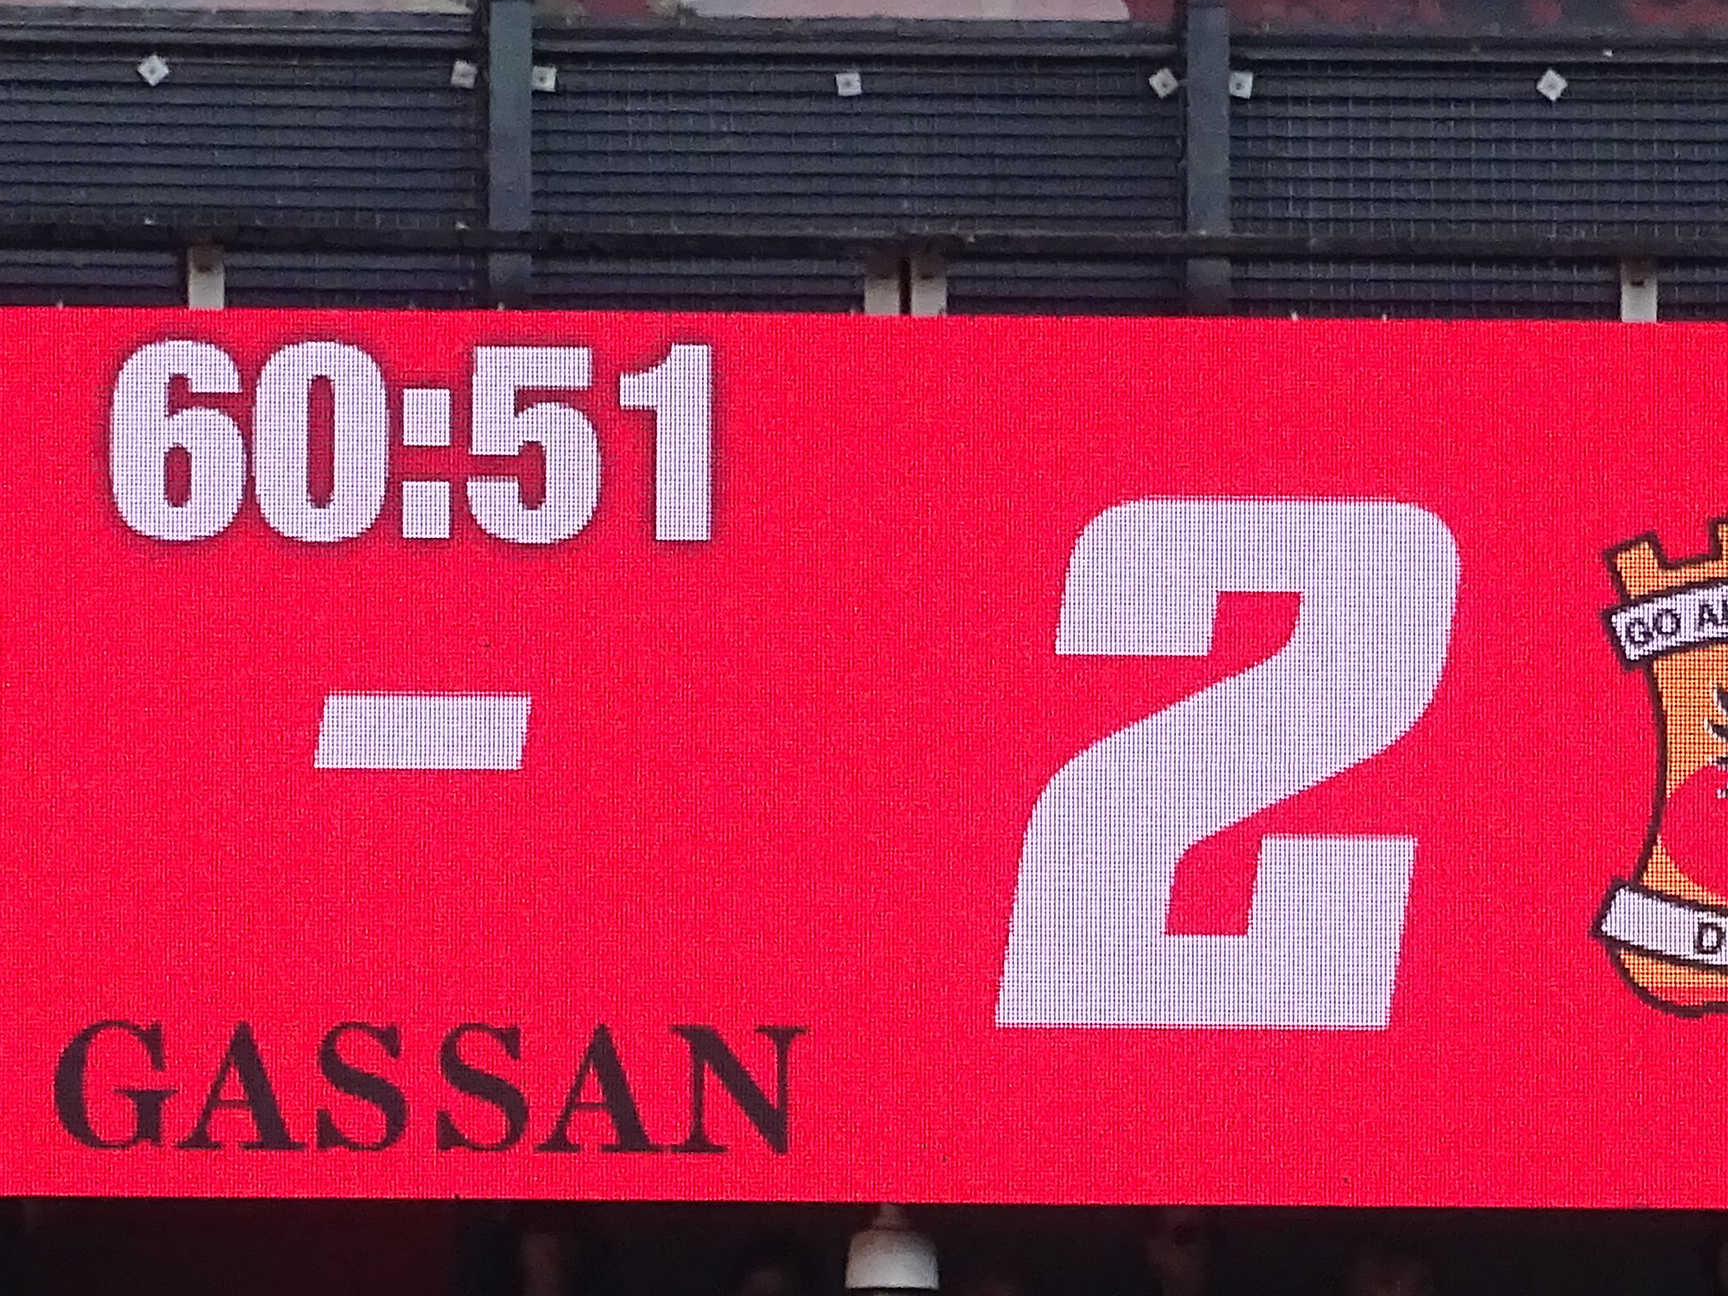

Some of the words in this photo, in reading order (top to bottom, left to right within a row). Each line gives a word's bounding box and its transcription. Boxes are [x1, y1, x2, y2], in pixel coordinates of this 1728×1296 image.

[108, 339, 712, 543] 60:51
[1625, 608, 1683, 647] GO
[996, 495, 1460, 1032] 2
[53, 1018, 806, 1155] GASSAN
